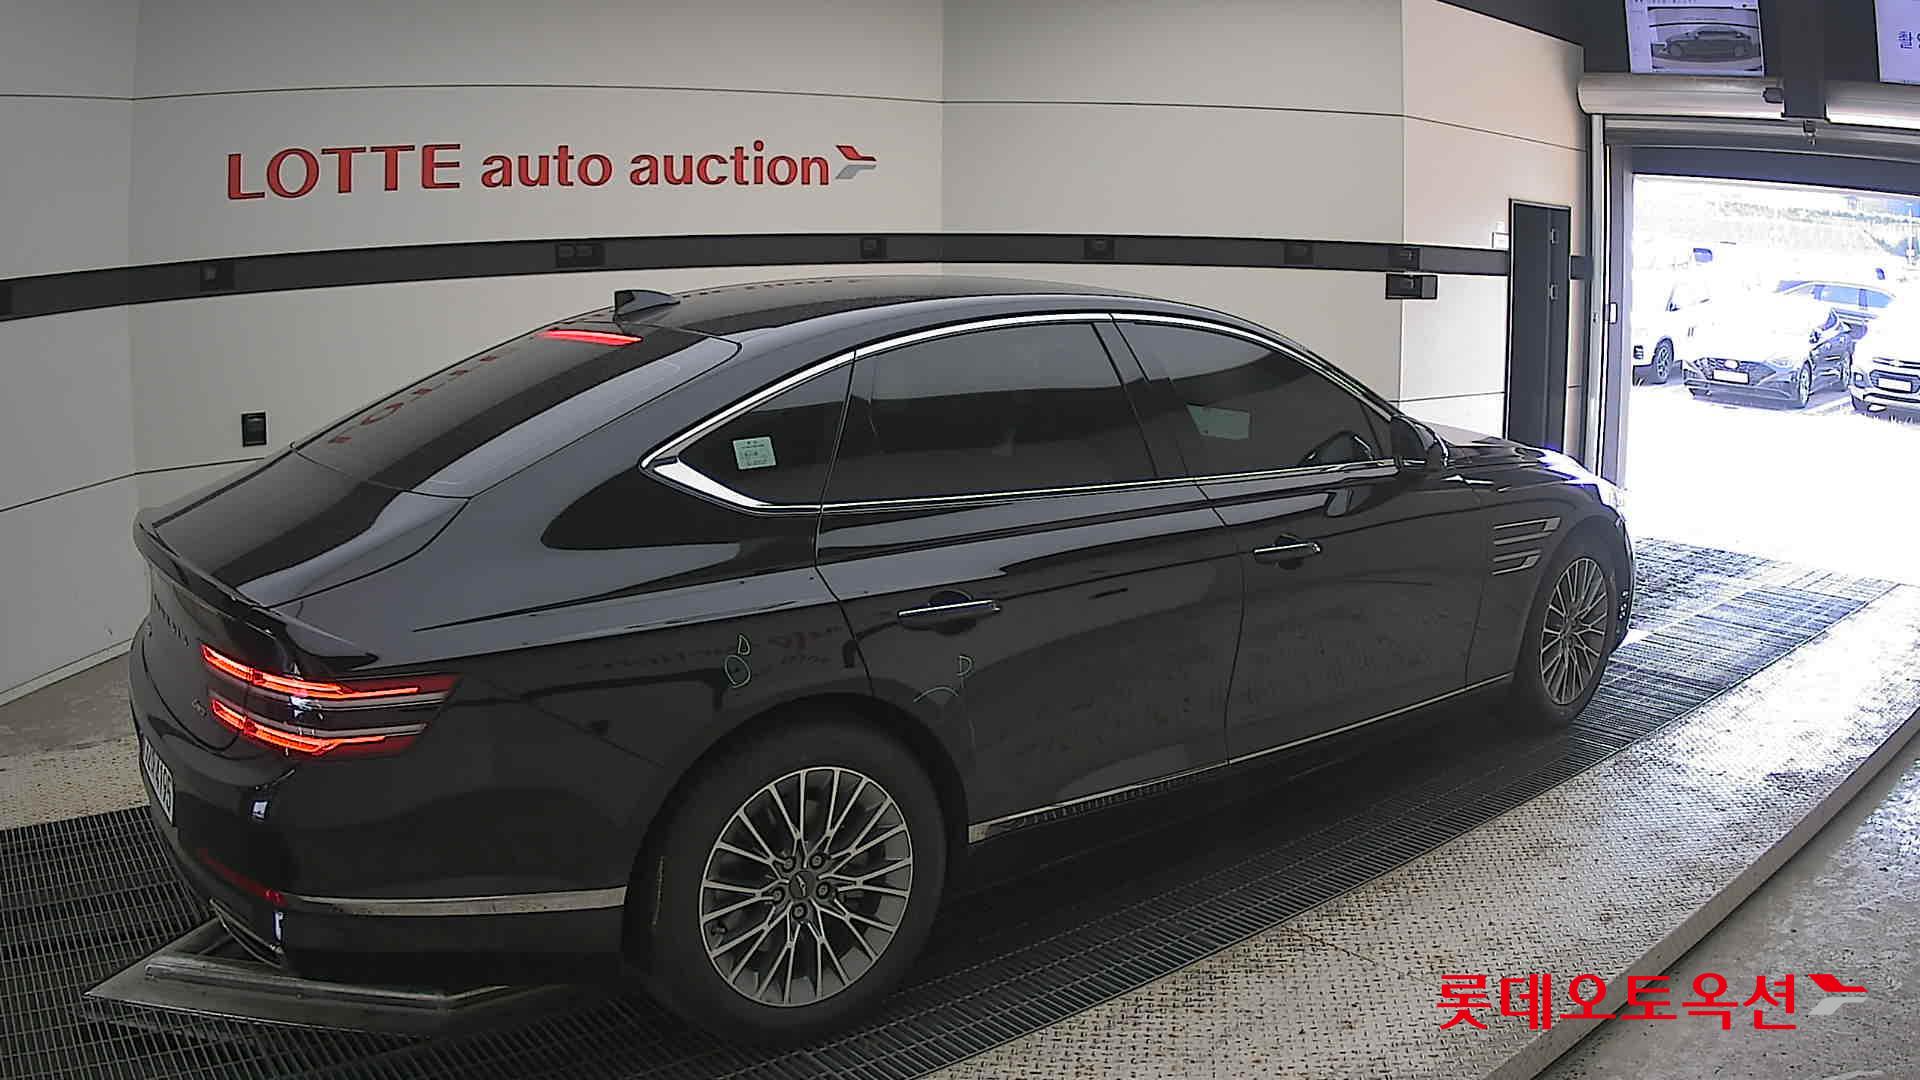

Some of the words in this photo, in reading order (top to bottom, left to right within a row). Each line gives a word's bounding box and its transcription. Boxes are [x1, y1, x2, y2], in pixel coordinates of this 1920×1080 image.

[227, 143, 461, 200] LOTTE
[481, 144, 613, 188] auto
[629, 139, 830, 186] auction
